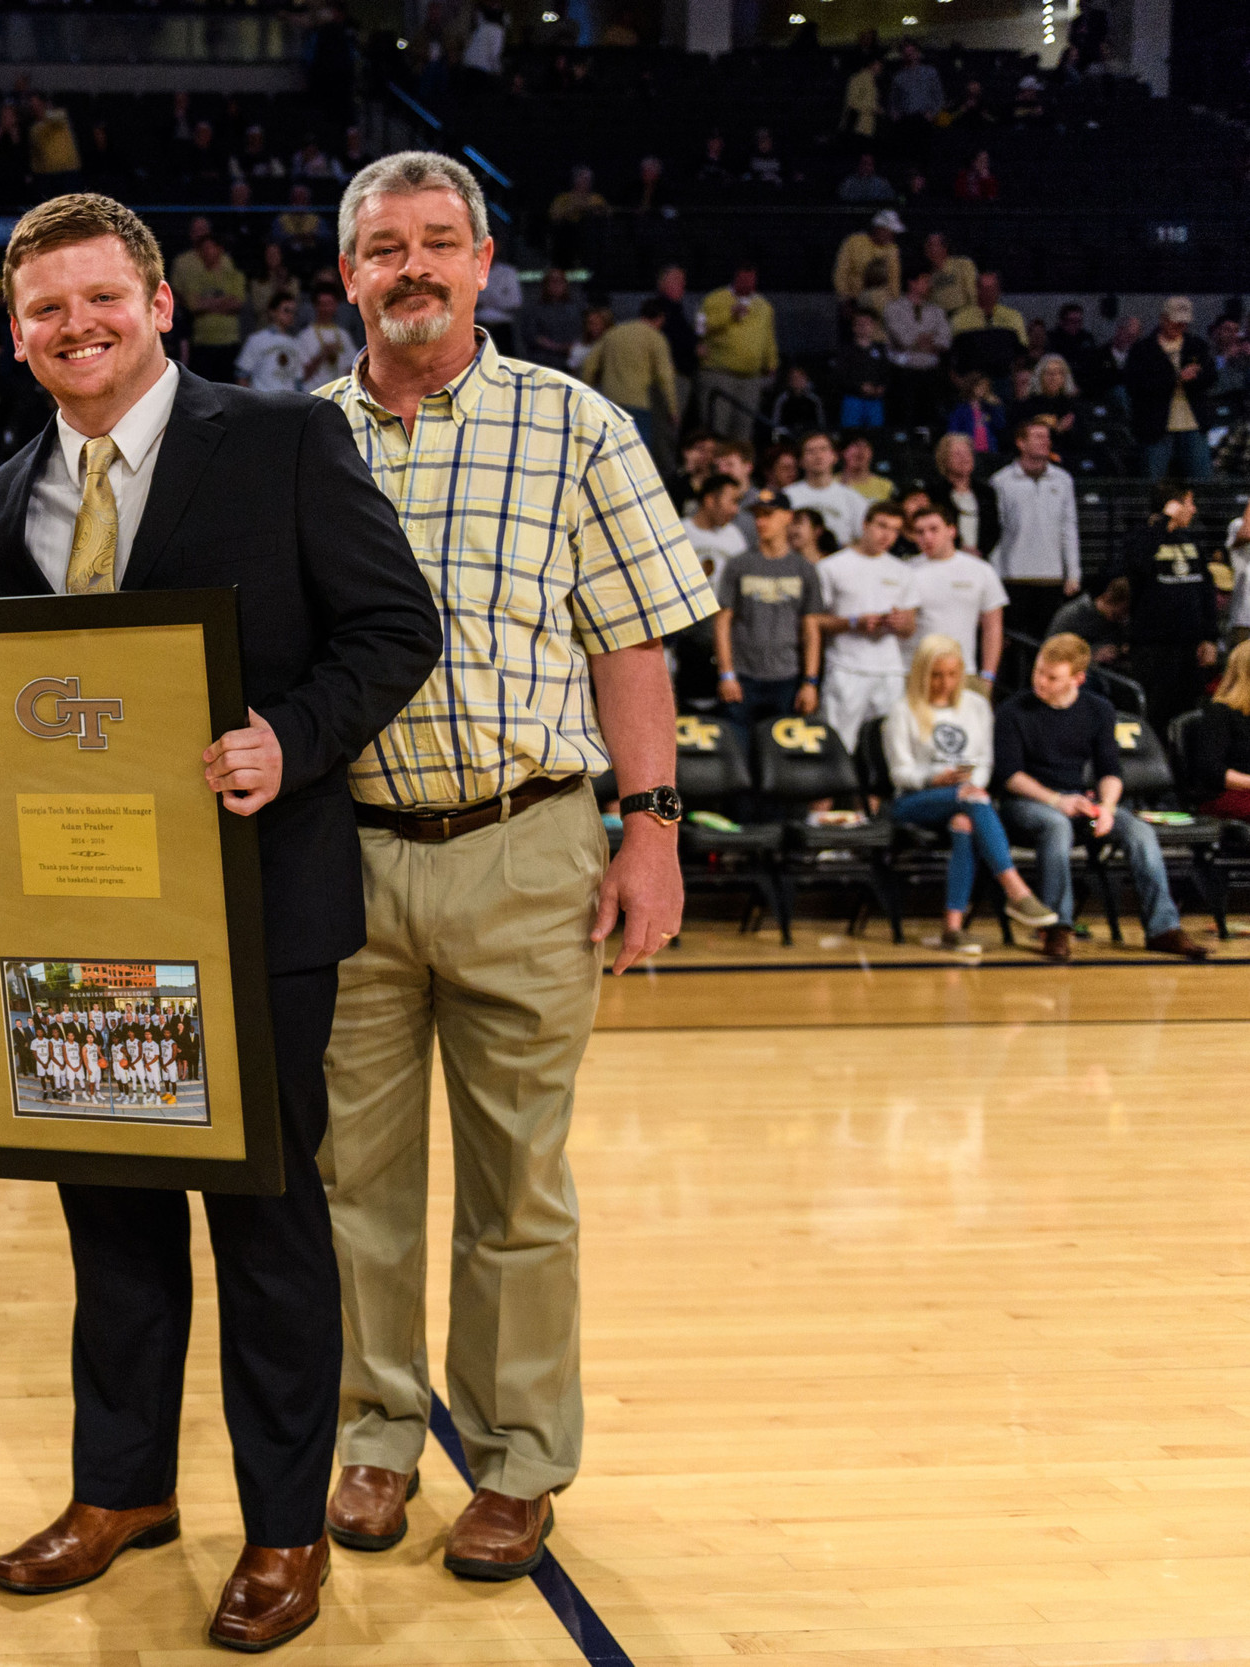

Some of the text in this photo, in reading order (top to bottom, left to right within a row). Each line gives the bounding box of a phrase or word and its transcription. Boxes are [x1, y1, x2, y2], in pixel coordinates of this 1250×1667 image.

[15, 677, 124, 750] GT
[771, 717, 827, 753] GT
[21, 806, 152, 816] Georgia Tech Men's Basketball Manager
[60, 823, 114, 831] Adam Prather
[95, 864, 135, 872] contributions
[67, 876, 98, 884] basketball
